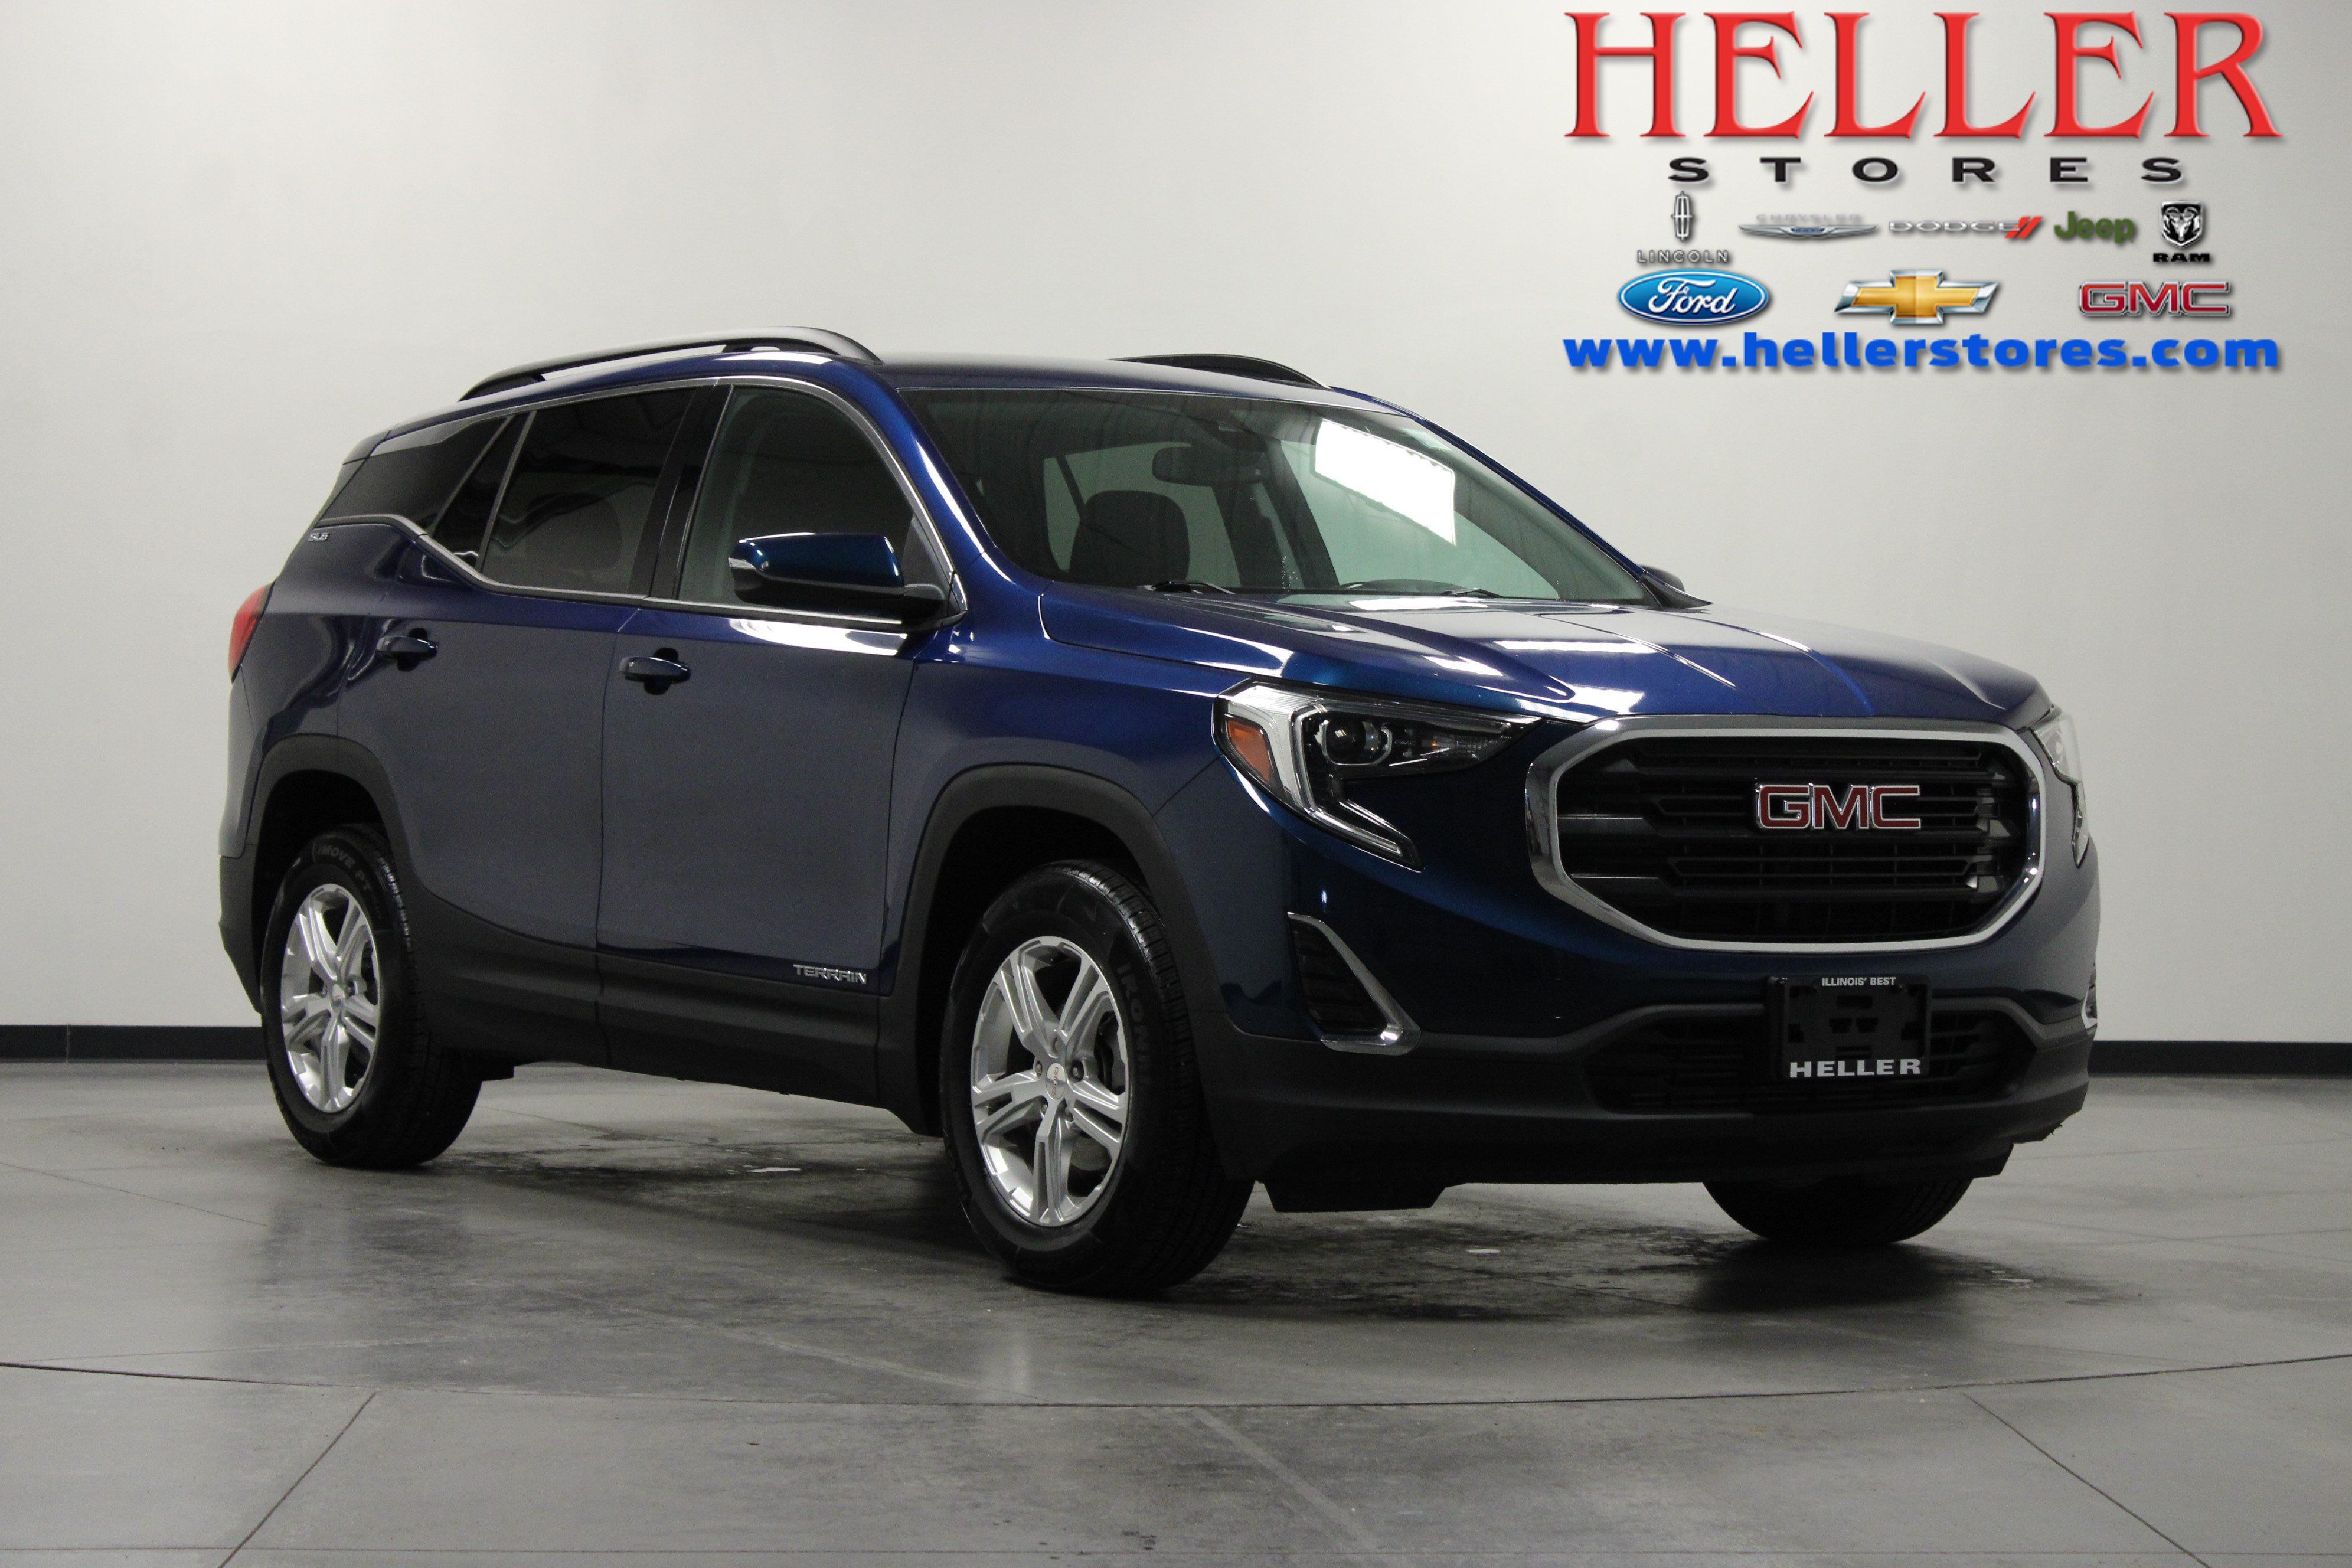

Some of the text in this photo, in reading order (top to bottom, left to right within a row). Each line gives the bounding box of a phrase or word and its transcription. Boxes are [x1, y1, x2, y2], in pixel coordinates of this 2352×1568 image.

[1755, 783, 1922, 830] GMC
[793, 963, 867, 985] TERRAIN
[1821, 976, 1897, 987] ILLINOIS' BEST
[1789, 1059, 1921, 1079] HELLER
